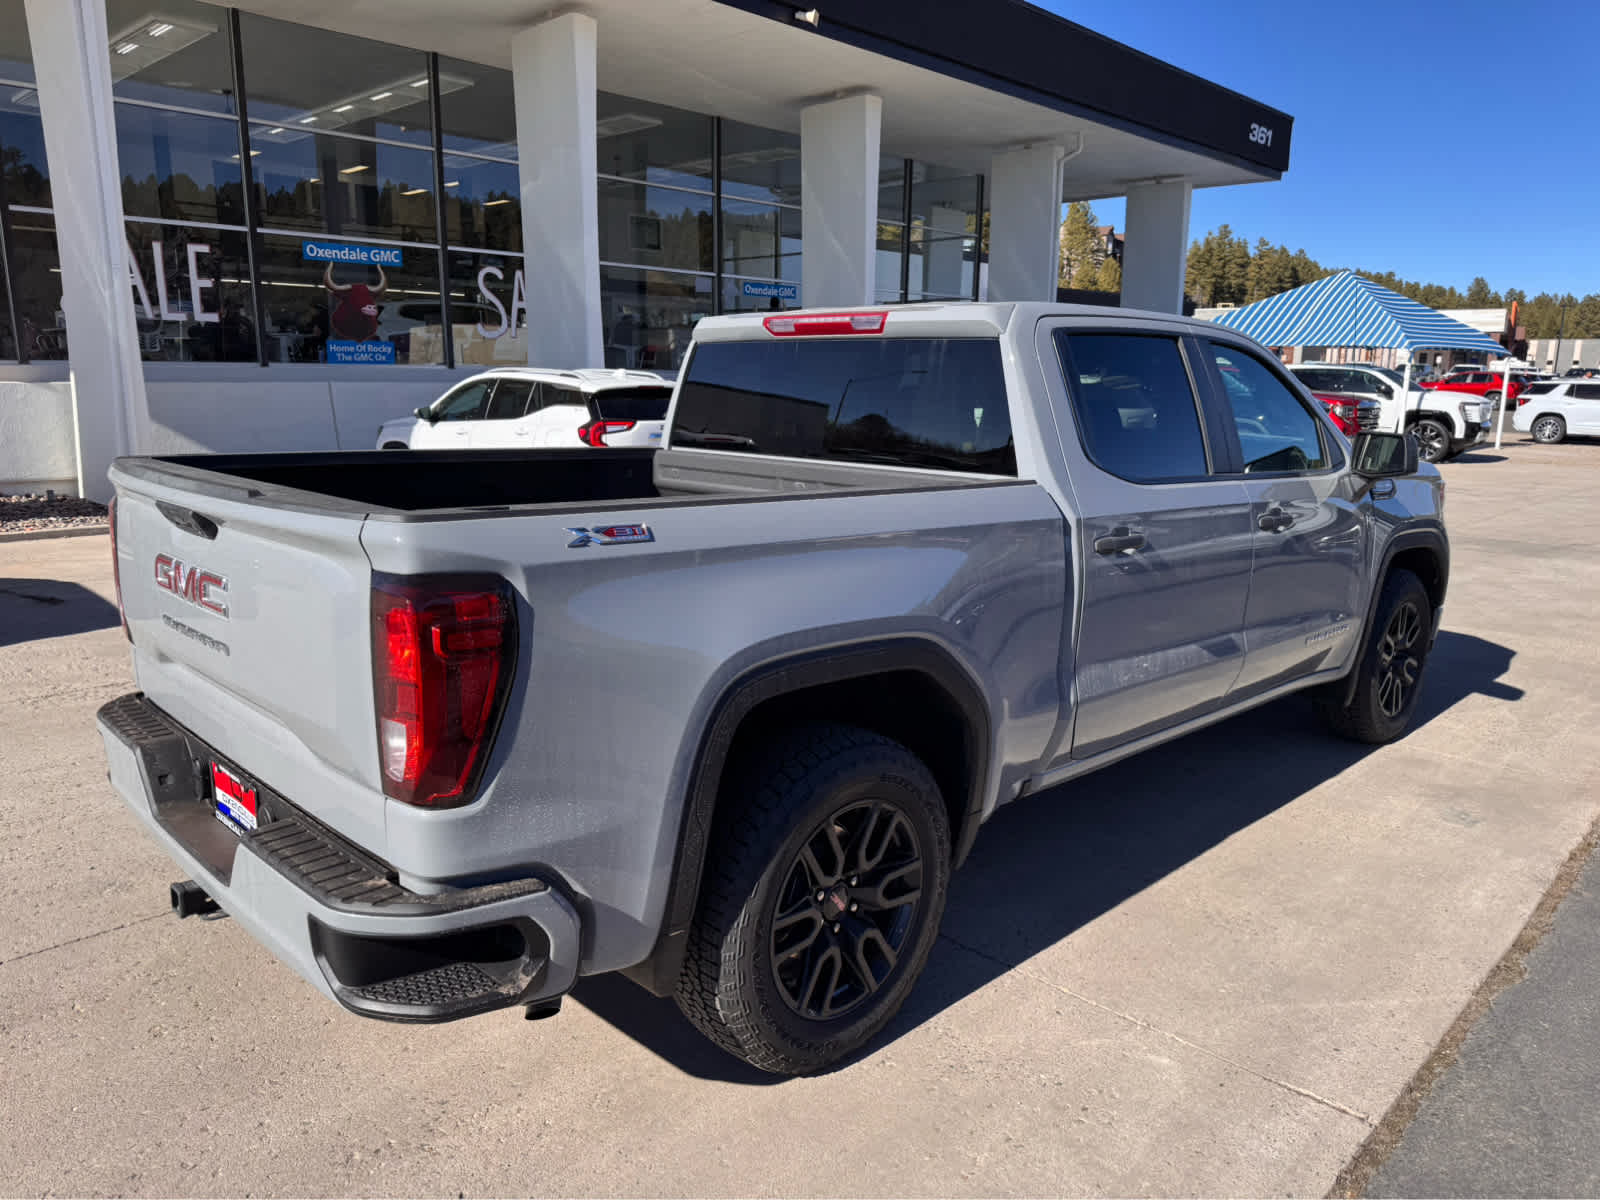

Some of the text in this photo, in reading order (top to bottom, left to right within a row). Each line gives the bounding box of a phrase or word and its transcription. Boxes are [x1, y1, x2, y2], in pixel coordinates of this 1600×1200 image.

[1249, 123, 1272, 147] 361
[306, 244, 400, 263] Oxendale GMC
[779, 287, 796, 297] GMC
[329, 343, 392, 354] Home Of Rocky
[336, 352, 387, 361] The GMC Ox
[155, 552, 229, 621] GMC
